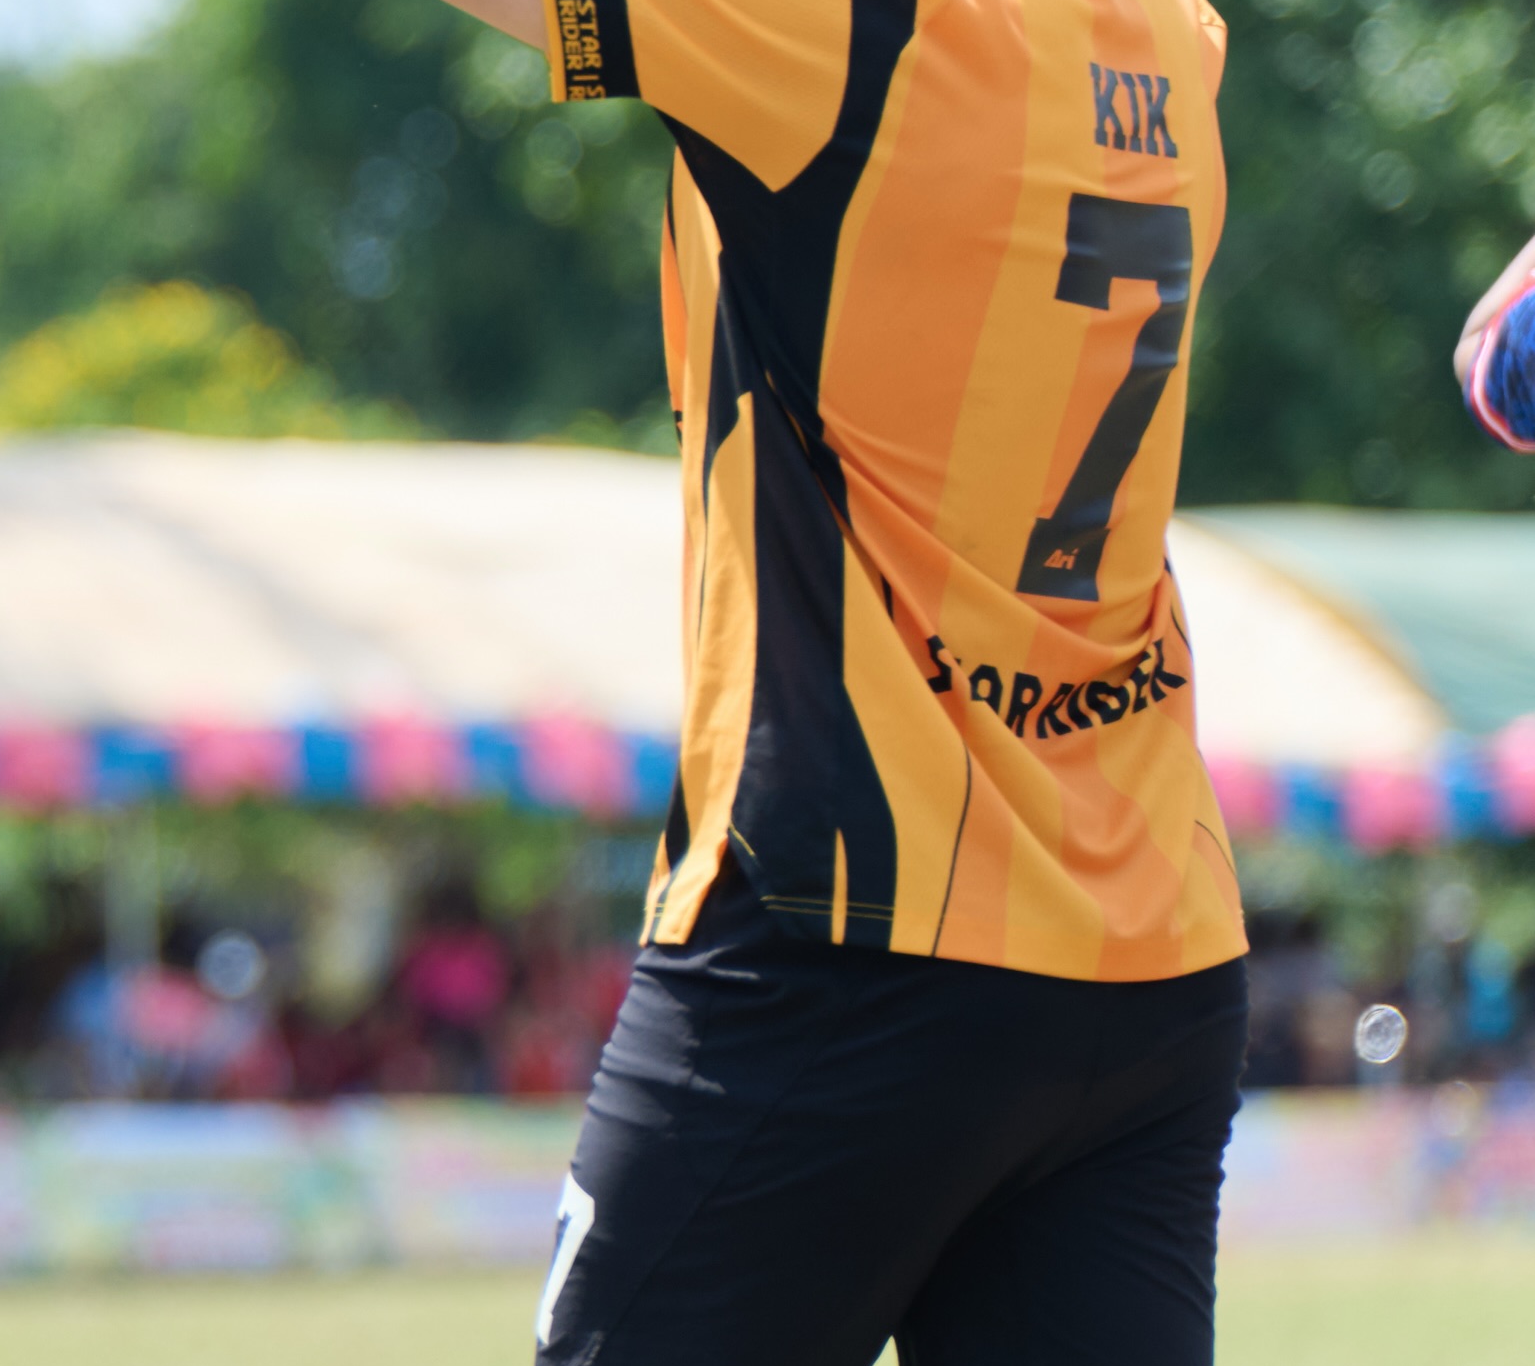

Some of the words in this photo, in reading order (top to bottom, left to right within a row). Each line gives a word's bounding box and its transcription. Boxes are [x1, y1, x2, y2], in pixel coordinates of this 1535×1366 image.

[558, 0, 583, 70] RIDER
[1089, 61, 1178, 158] KIK
[1015, 192, 1194, 602] 7
[1043, 547, 1080, 571] Ari
[536, 1170, 596, 1346] 7
